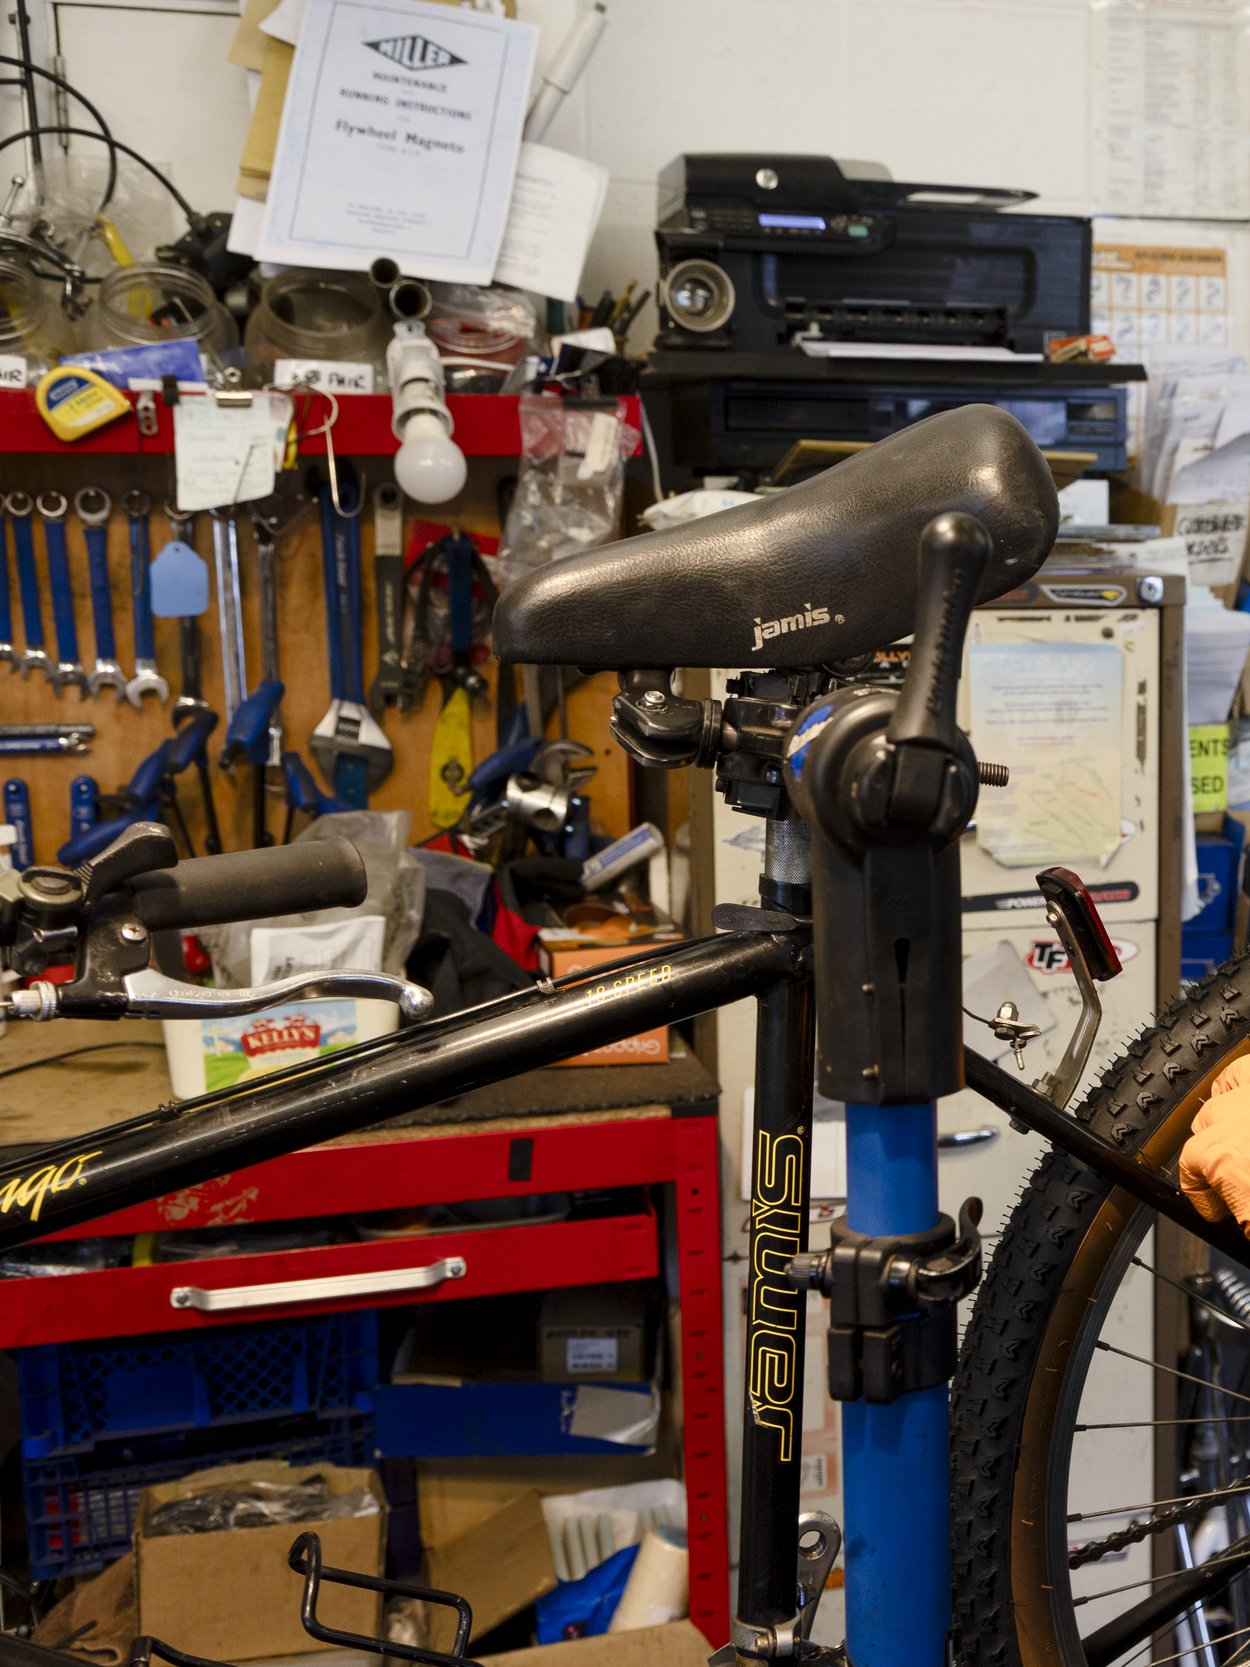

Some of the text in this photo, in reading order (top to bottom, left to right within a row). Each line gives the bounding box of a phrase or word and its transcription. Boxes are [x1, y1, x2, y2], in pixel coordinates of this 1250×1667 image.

[377, 35, 452, 69] MILLER
[372, 71, 447, 94] MAINTENANCE
[339, 88, 472, 121] RUNNING INSTRUCTIONS
[335, 118, 397, 137] Flywheel
[405, 131, 466, 154] Magneto
[751, 603, 831, 651] jamis
[613, 963, 672, 998] SPEED
[247, 1028, 317, 1049] KELLY'S
